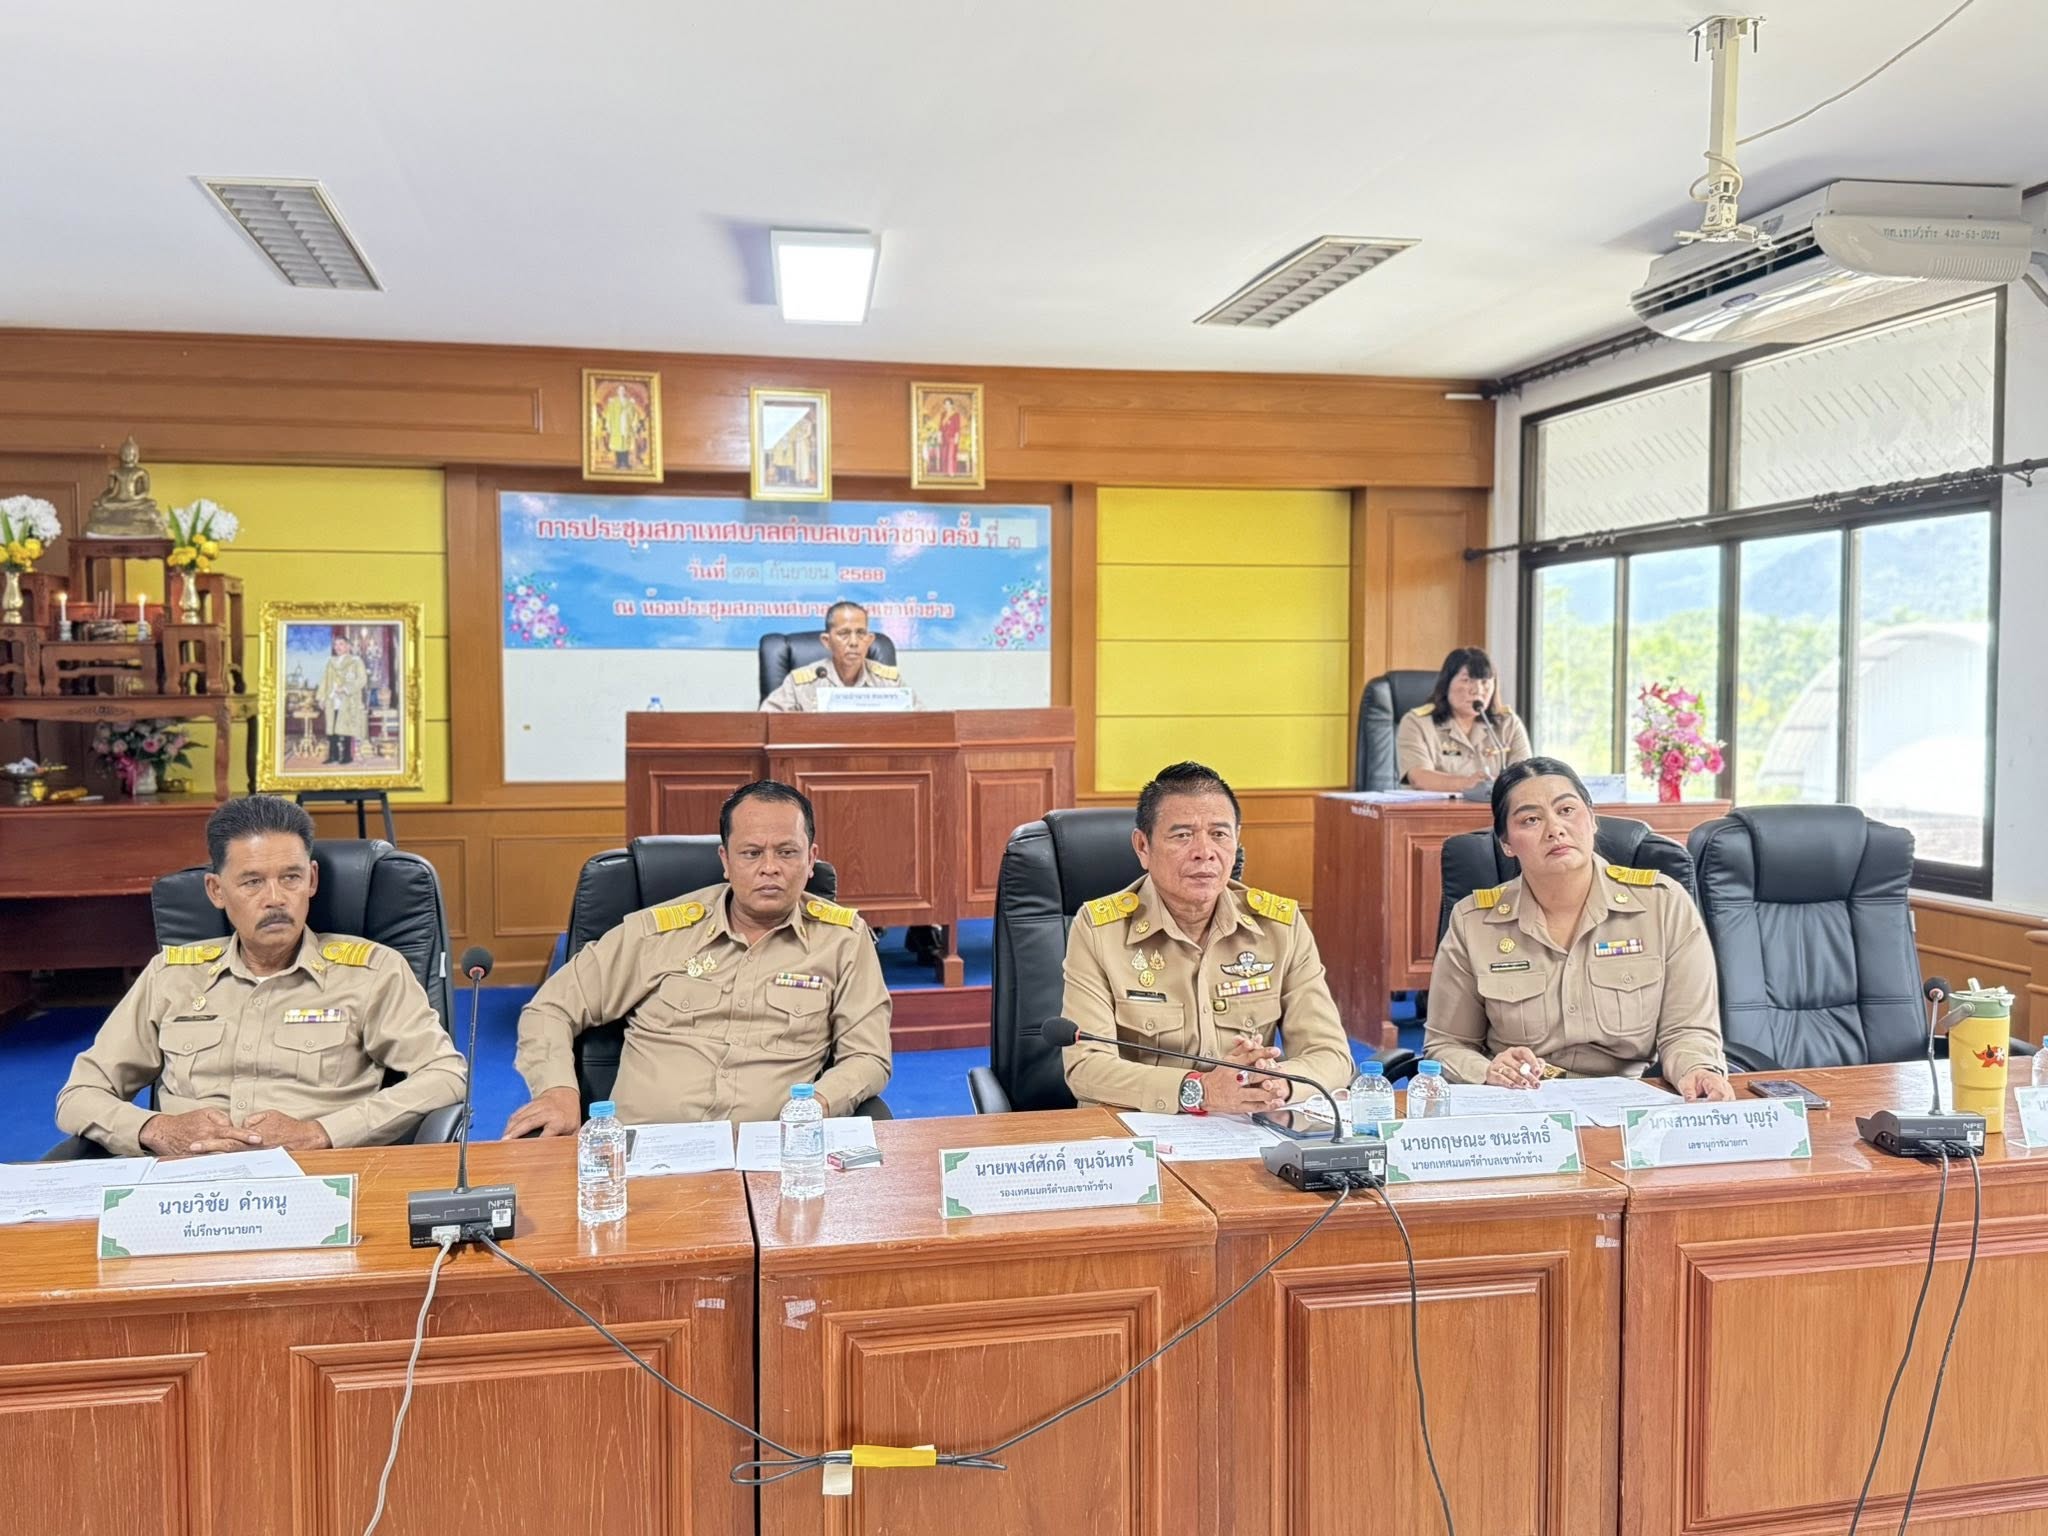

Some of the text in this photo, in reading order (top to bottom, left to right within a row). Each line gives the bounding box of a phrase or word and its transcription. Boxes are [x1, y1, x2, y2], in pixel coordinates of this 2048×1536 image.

[1650, 1106, 1779, 1129] นางสาวมาริษา บุญรุ่ง
[1400, 1118, 1551, 1154] นายกฤษณะ ชนะสิทธิ์
[975, 1147, 1135, 1177] นายพงศ์ศักดิ์ ขุนจันทร์
[1411, 1152, 1543, 1170] นายกเทศมนตรีตำบลเขาหัวช้าง
[158, 1190, 288, 1216] นายวิชัย ดำหนู
[488, 1199, 514, 1209] NPE
[183, 1221, 263, 1238] ที่ปรึกษานายกฯ
